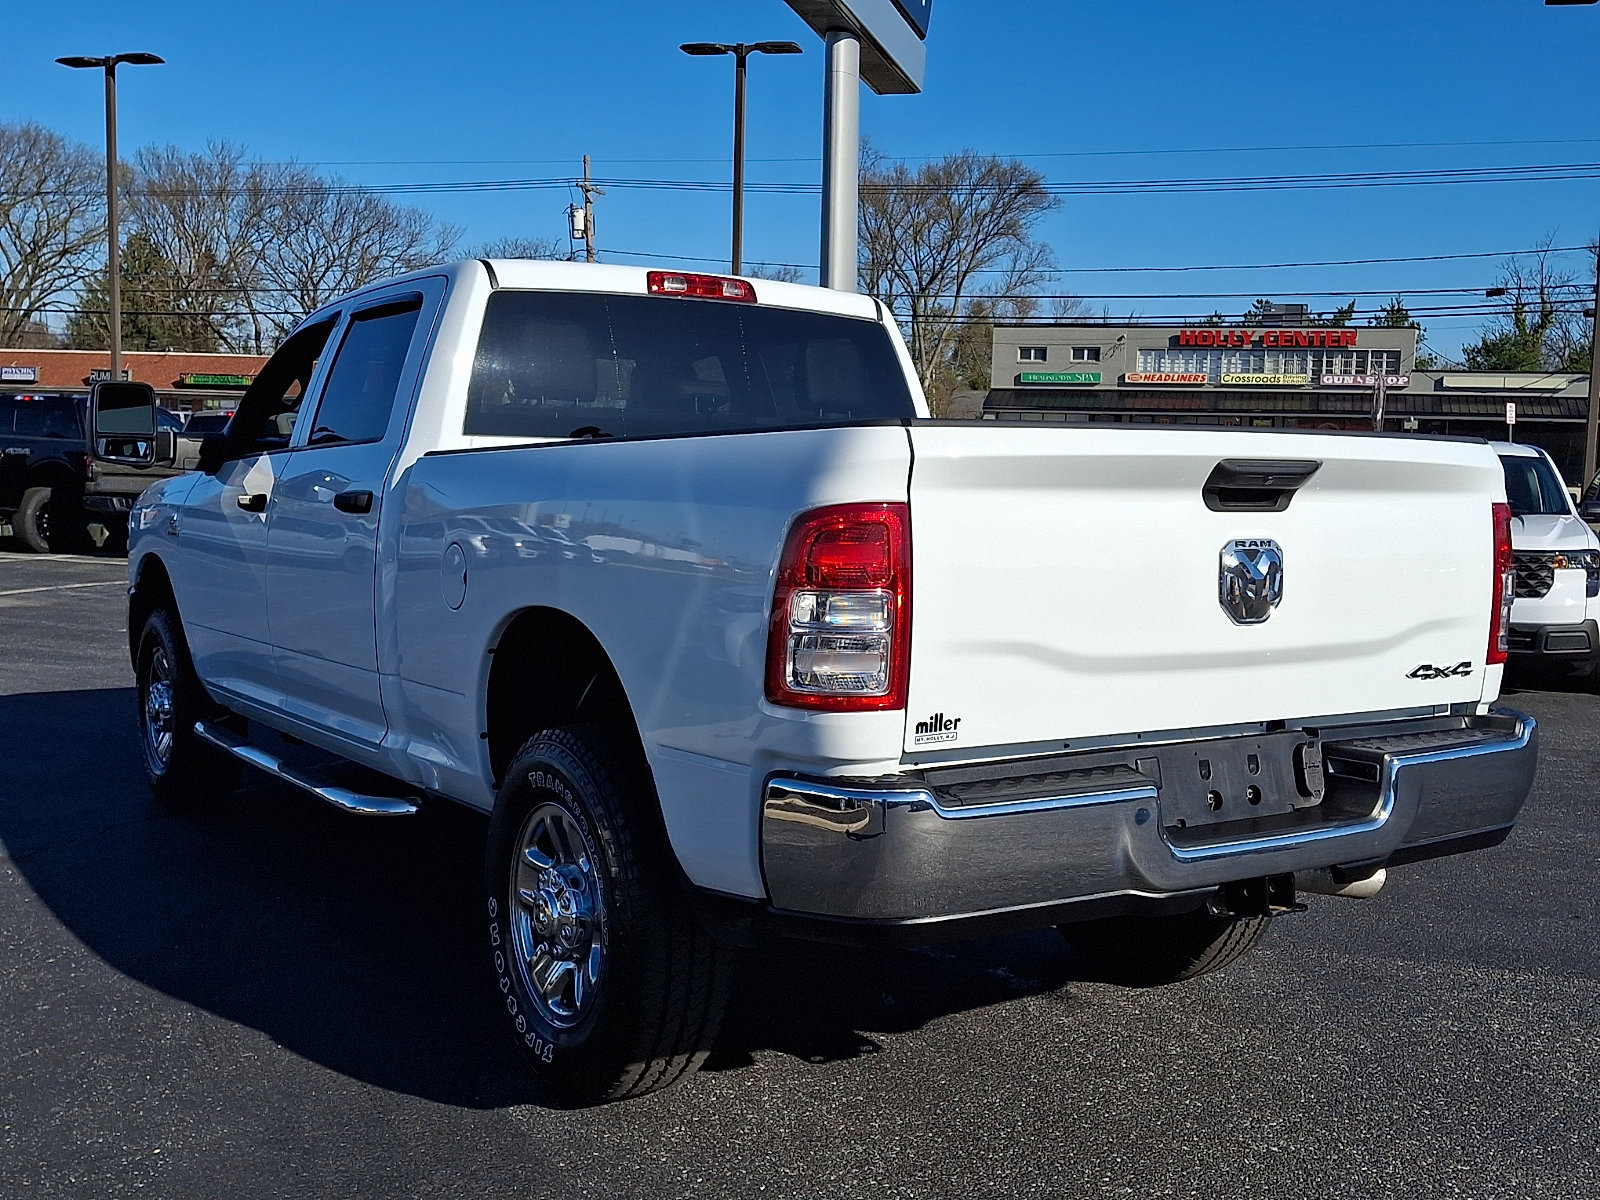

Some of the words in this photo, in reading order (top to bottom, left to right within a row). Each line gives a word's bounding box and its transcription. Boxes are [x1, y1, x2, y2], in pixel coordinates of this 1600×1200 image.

[1179, 330, 1256, 346] HOLLY
[1264, 331, 1358, 346] CENTER
[1075, 373, 1094, 382] SPA
[1143, 374, 1207, 382] HEADLINERS
[1222, 374, 1281, 383] Crossroads
[1323, 375, 1354, 384] GUN
[1365, 376, 1409, 385] SOP
[1234, 540, 1272, 548] RAM
[915, 712, 961, 734] miller
